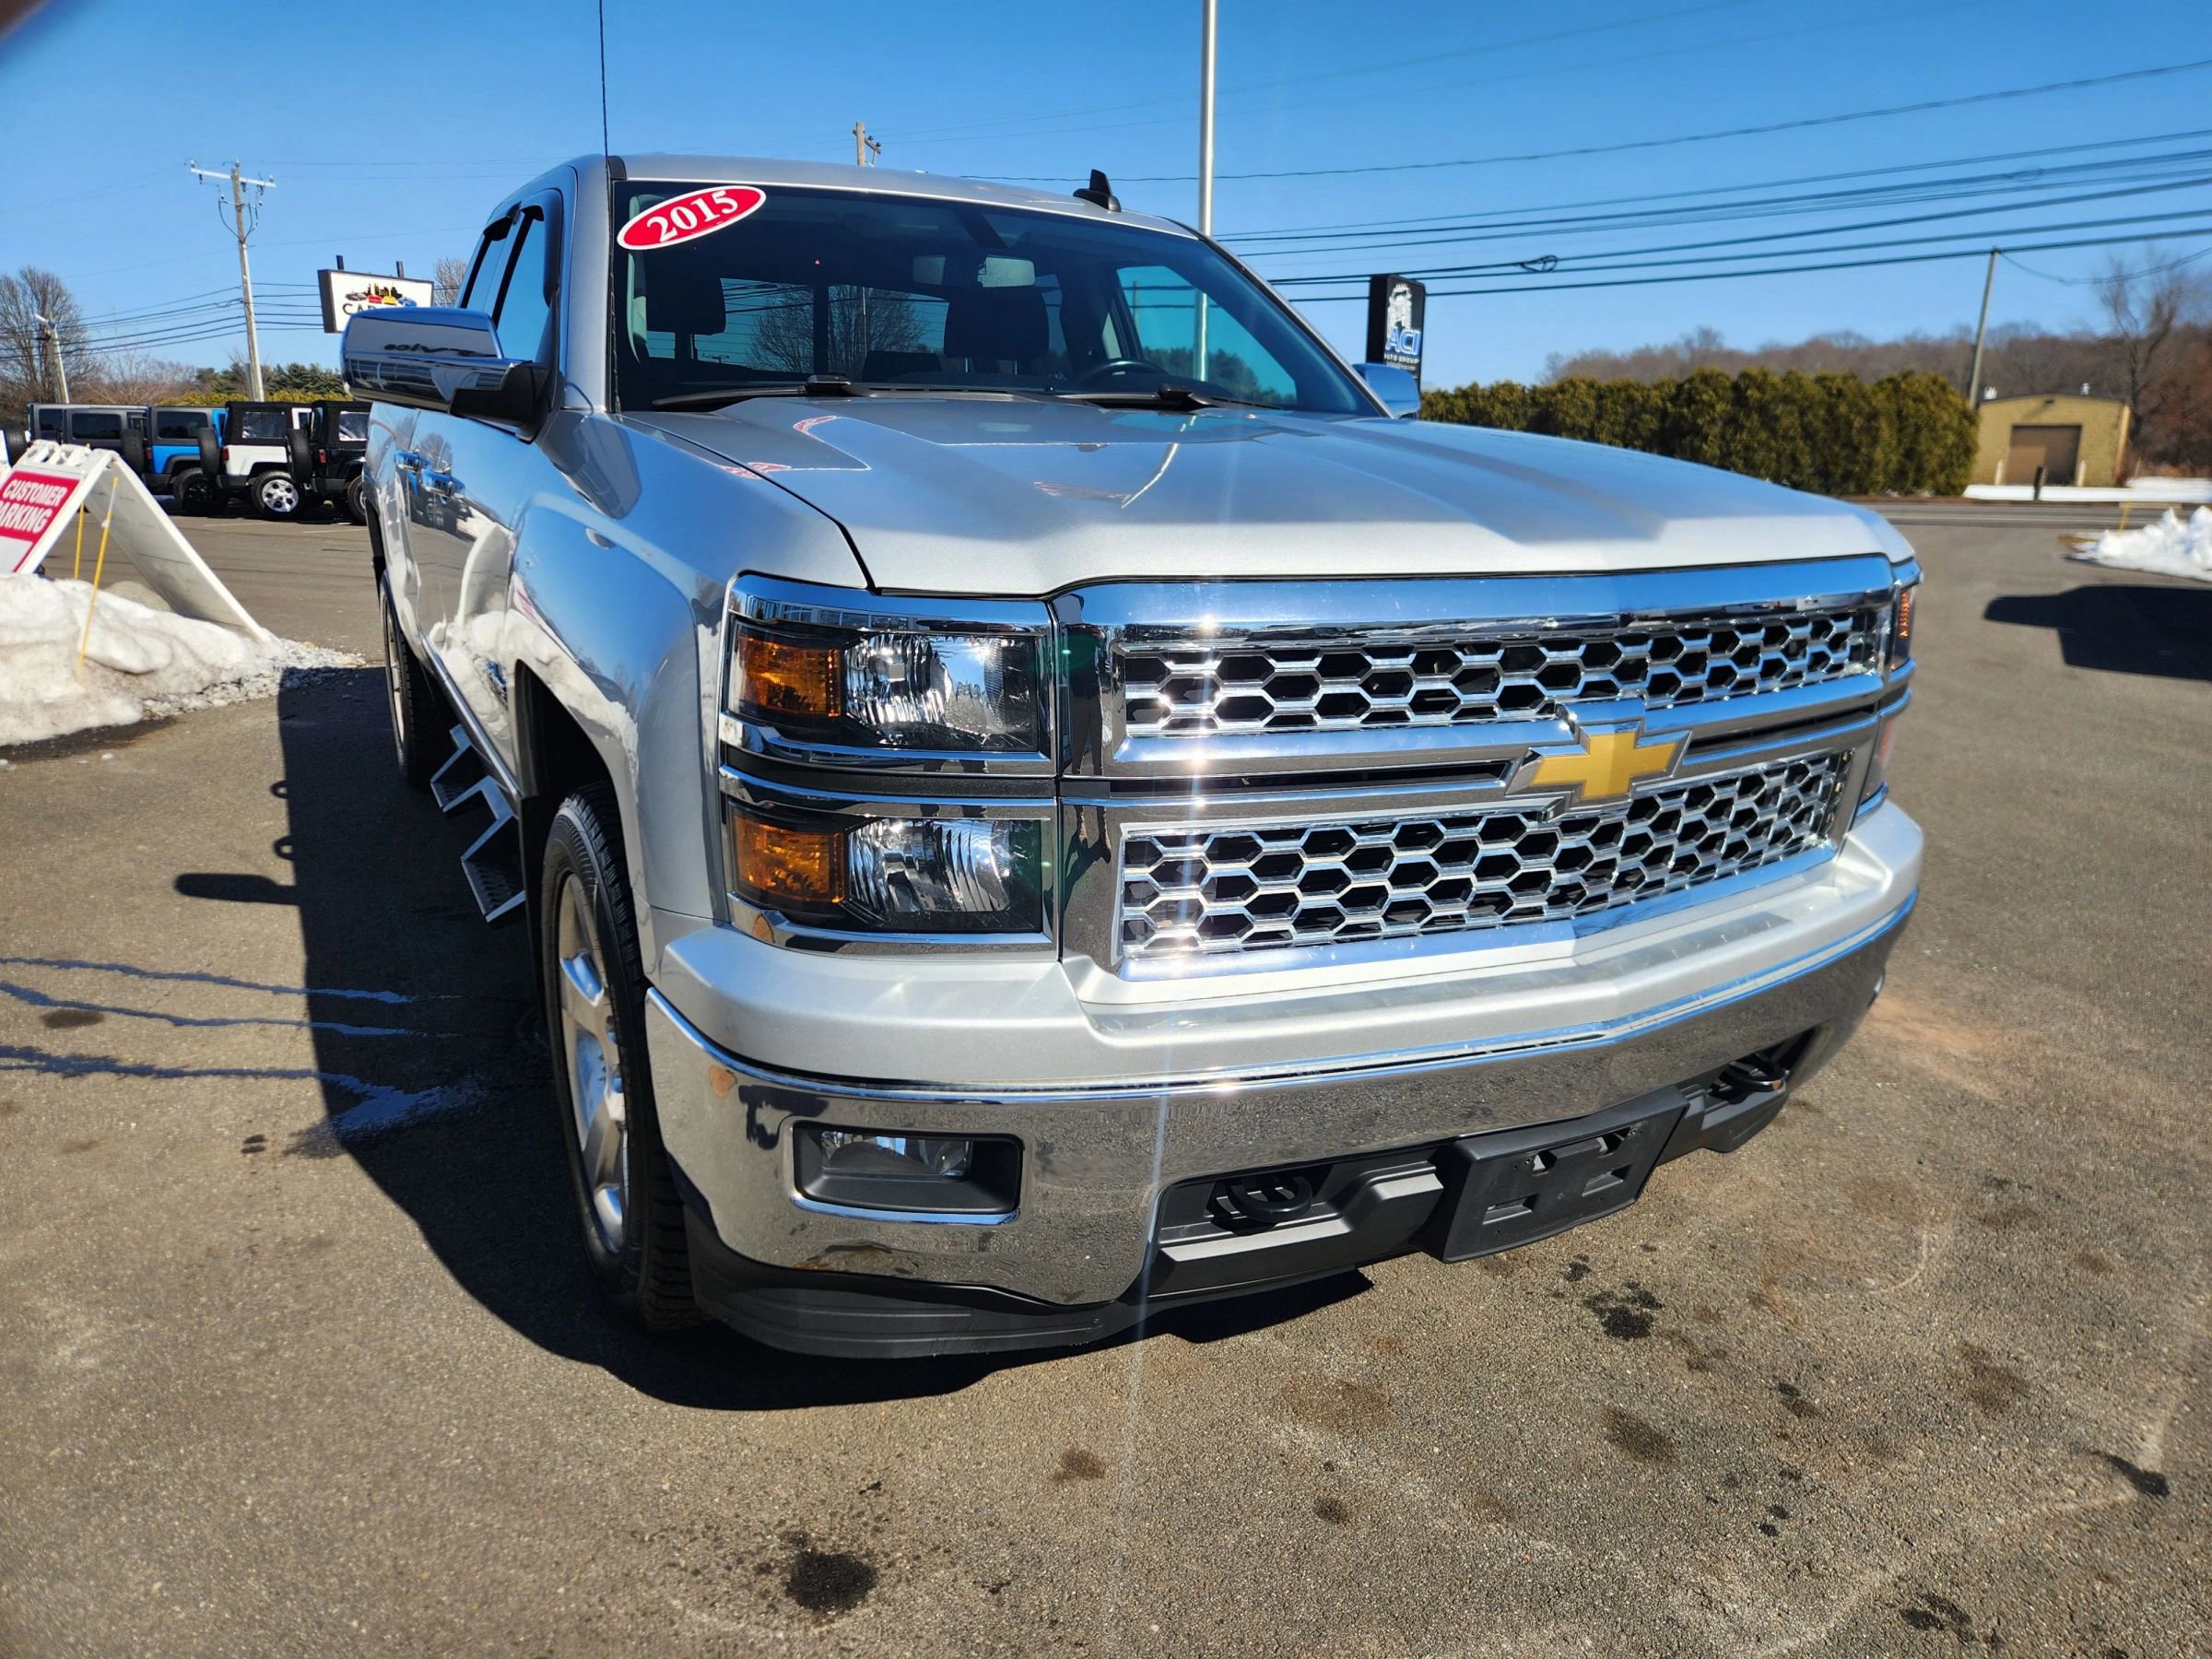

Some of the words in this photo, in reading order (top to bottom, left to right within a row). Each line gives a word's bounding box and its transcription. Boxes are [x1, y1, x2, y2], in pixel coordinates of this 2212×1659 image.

[646, 189, 739, 243] 2015
[1385, 326, 1421, 356] ACI
[2, 478, 68, 507] CUSTOMER
[0, 500, 53, 535] ARKING
